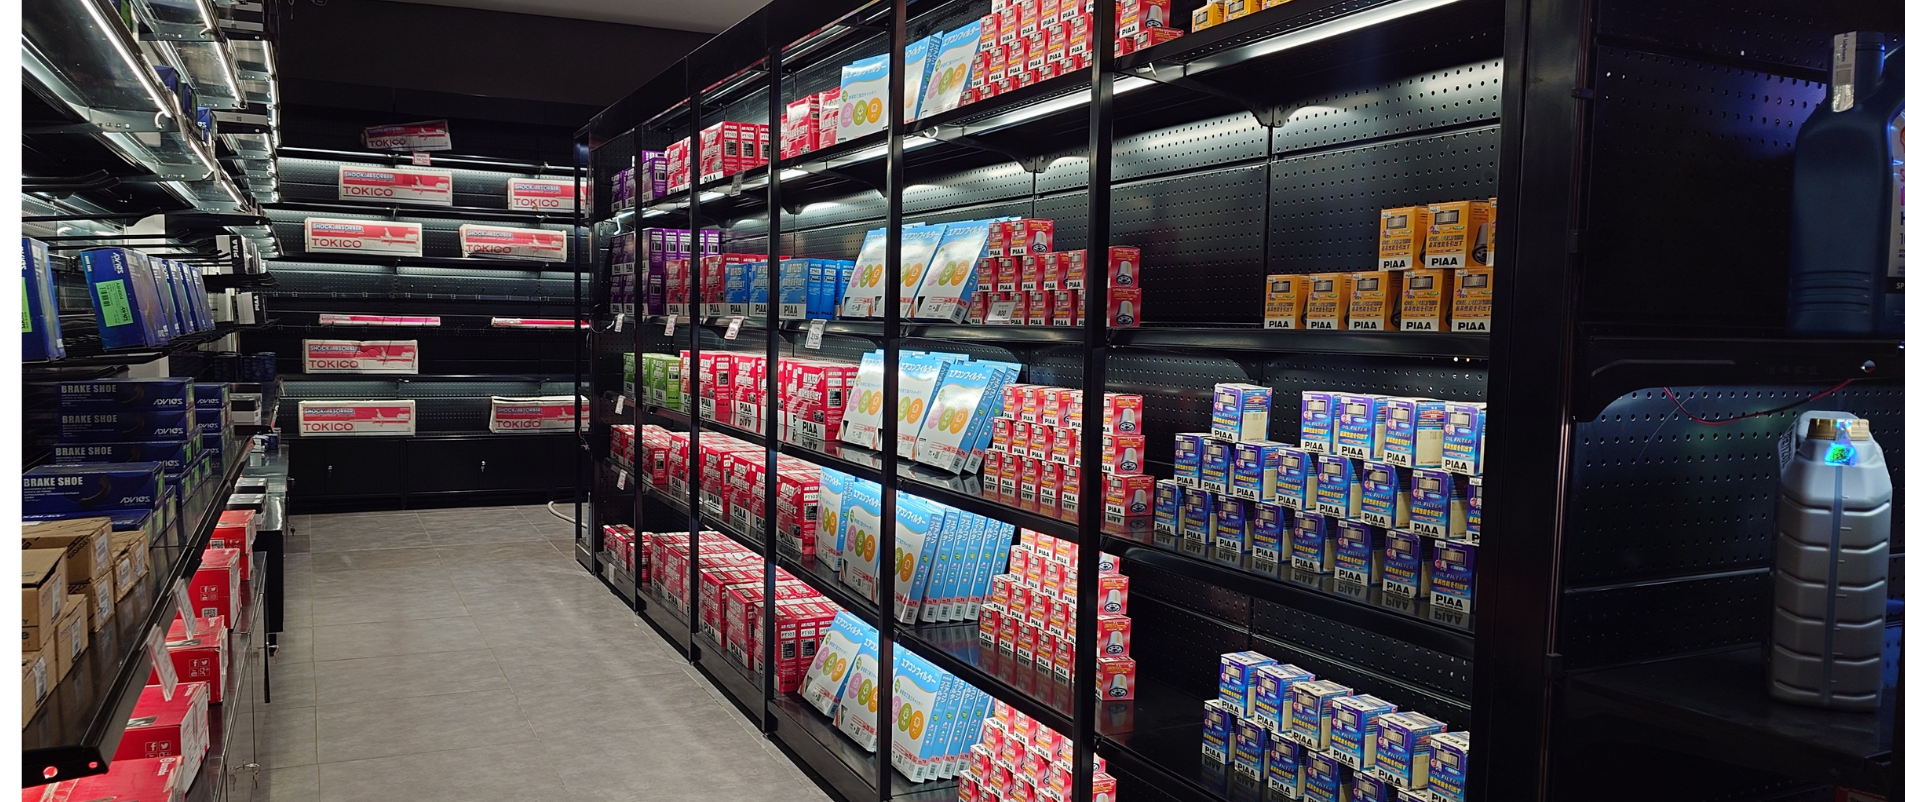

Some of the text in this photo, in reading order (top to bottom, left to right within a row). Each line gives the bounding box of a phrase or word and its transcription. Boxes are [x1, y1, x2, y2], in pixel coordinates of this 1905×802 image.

[1062, 10, 1074, 18] PIAA
[1122, 26, 1136, 35] PIAA
[369, 138, 406, 146] TOKICO
[343, 186, 393, 196] TOKICO
[514, 198, 559, 207] TOKICO
[312, 238, 362, 248] TOKICO
[467, 245, 511, 253] TOKICO
[1384, 260, 1406, 268] PIAA
[1432, 257, 1458, 266] PIAA
[784, 305, 797, 313] PIAA
[949, 370, 986, 381] エアコンフィルター
[61, 384, 116, 393] BRAKE SHOE
[62, 415, 92, 424] BRAKE
[803, 421, 817, 432] PIAA
[1215, 430, 1233, 440] PIAA
[1305, 442, 1323, 450] PIAA
[1342, 446, 1363, 456] PIAA
[56, 447, 112, 456] BRAKE SHOE
[1387, 453, 1406, 462] PIAA
[1445, 460, 1467, 470] PIAA
[24, 477, 83, 487] BRAKE SHOE
[1177, 476, 1194, 485] PIAA
[1204, 482, 1221, 491] PIAA
[1237, 488, 1254, 498] PIAA
[1278, 496, 1296, 505] PIAA
[734, 506, 746, 519] PIAA
[1320, 505, 1340, 514] PIAA
[1364, 514, 1385, 524] PIAA
[1157, 523, 1171, 532] PIAA
[1414, 523, 1438, 534] PIAA
[1186, 531, 1201, 540] PIAA
[1220, 539, 1237, 549] PIAA
[1256, 548, 1274, 558] PIAA
[1295, 558, 1314, 569] PIAA
[1339, 570, 1361, 581] PIAA
[1387, 582, 1409, 594] PIAA
[1436, 594, 1463, 608] PIAA
[1031, 619, 1041, 627] PIAA
[1038, 658, 1048, 666] PIAA
[901, 657, 936, 684] エアコンフィルター
[1222, 701, 1239, 713] PIAA
[1258, 715, 1274, 728] PIAA
[1294, 732, 1312, 746] PIAA
[1205, 746, 1221, 759] PIAA
[1334, 750, 1354, 764] PIAA
[1238, 762, 1255, 777] PIAA
[1379, 770, 1401, 785] PIAA
[1272, 778, 1290, 793] PIAA
